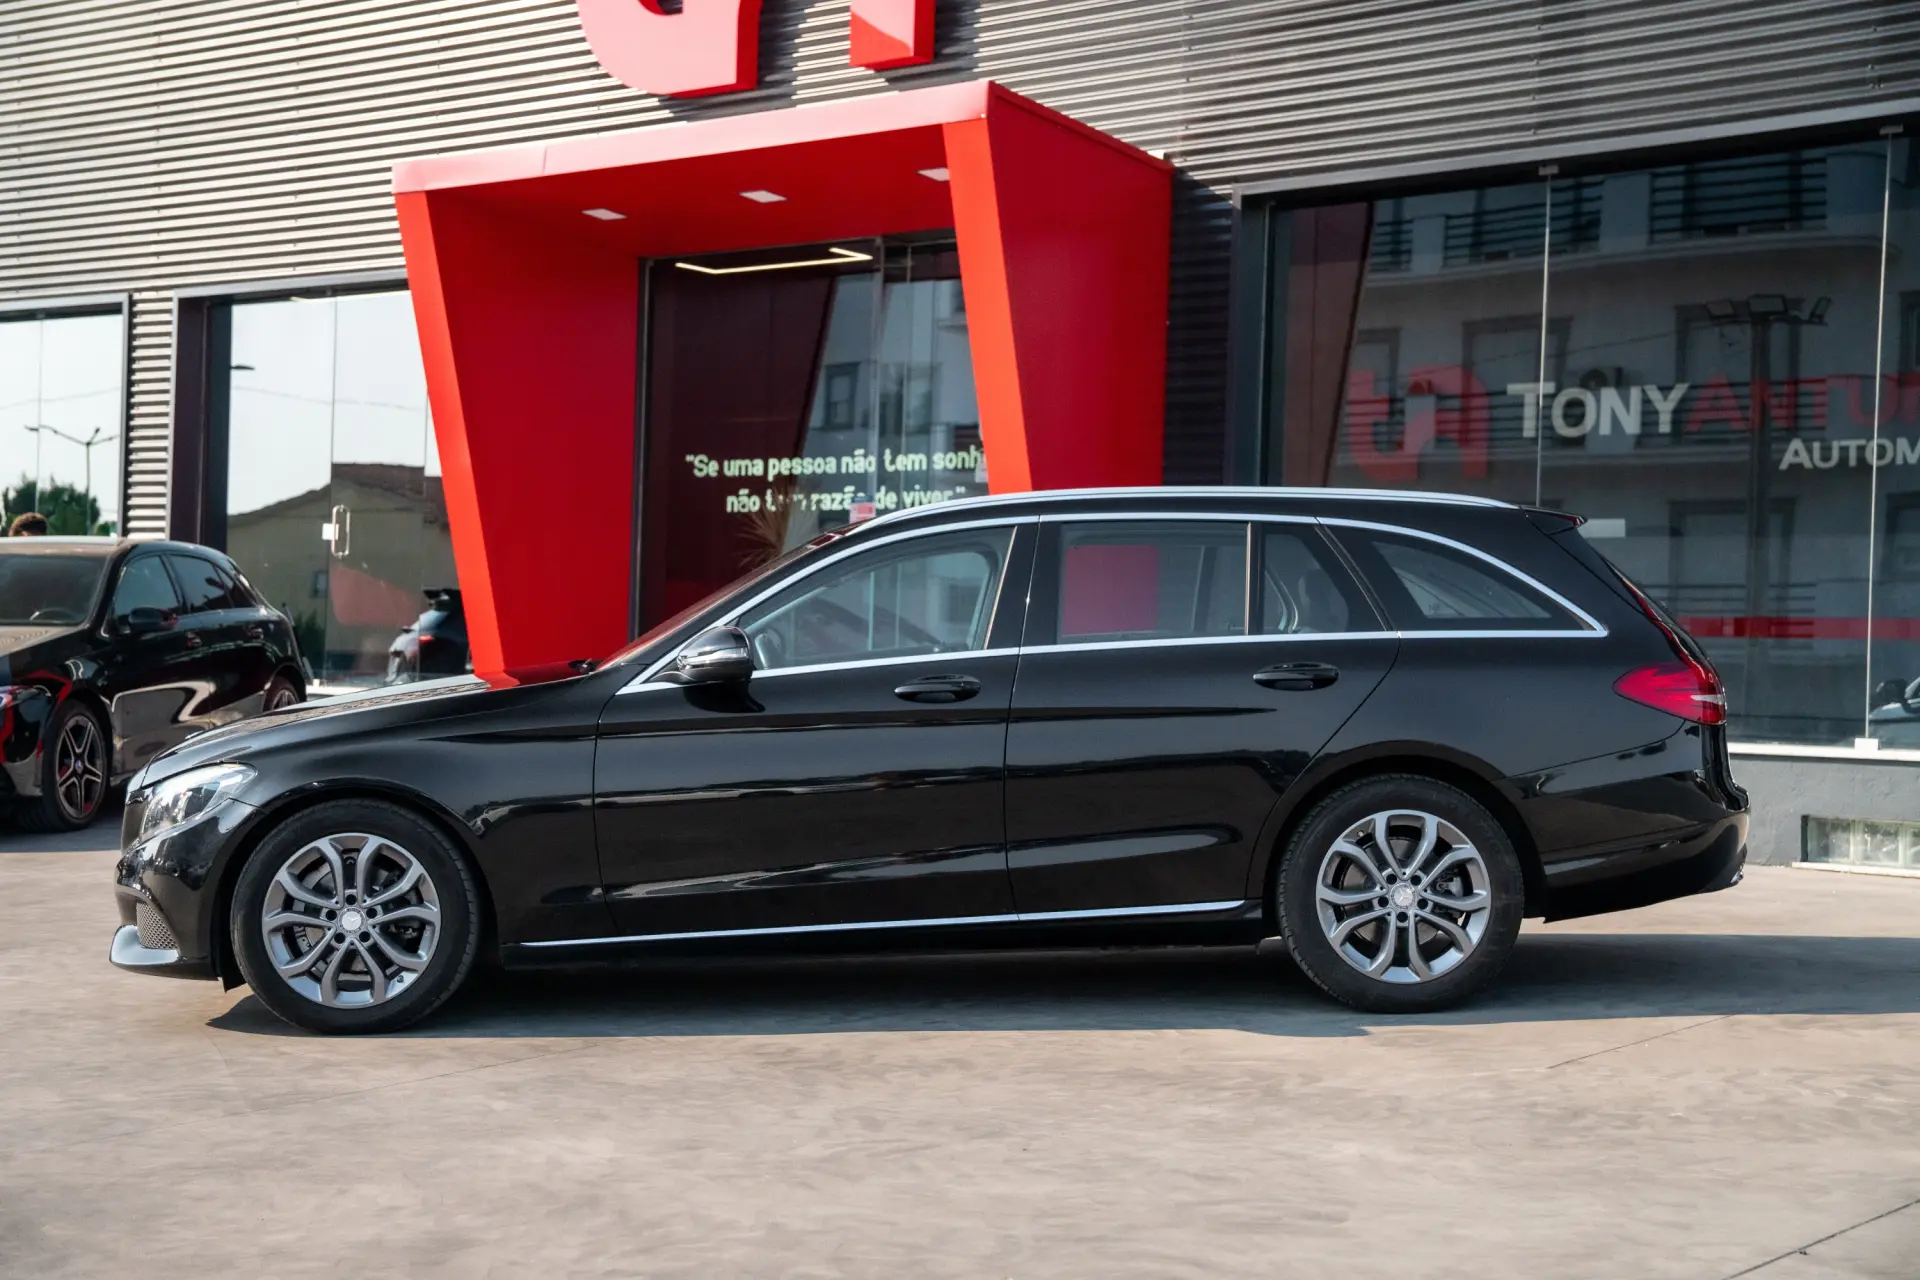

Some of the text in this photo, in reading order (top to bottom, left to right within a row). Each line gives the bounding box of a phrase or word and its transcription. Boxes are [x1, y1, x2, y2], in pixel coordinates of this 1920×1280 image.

[1507, 382, 1690, 438] TONY
[685, 445, 985, 482] "Se uma pessoa não tem sonh
[726, 488, 761, 513] não
[811, 485, 866, 511] razã
[875, 485, 898, 510] de
